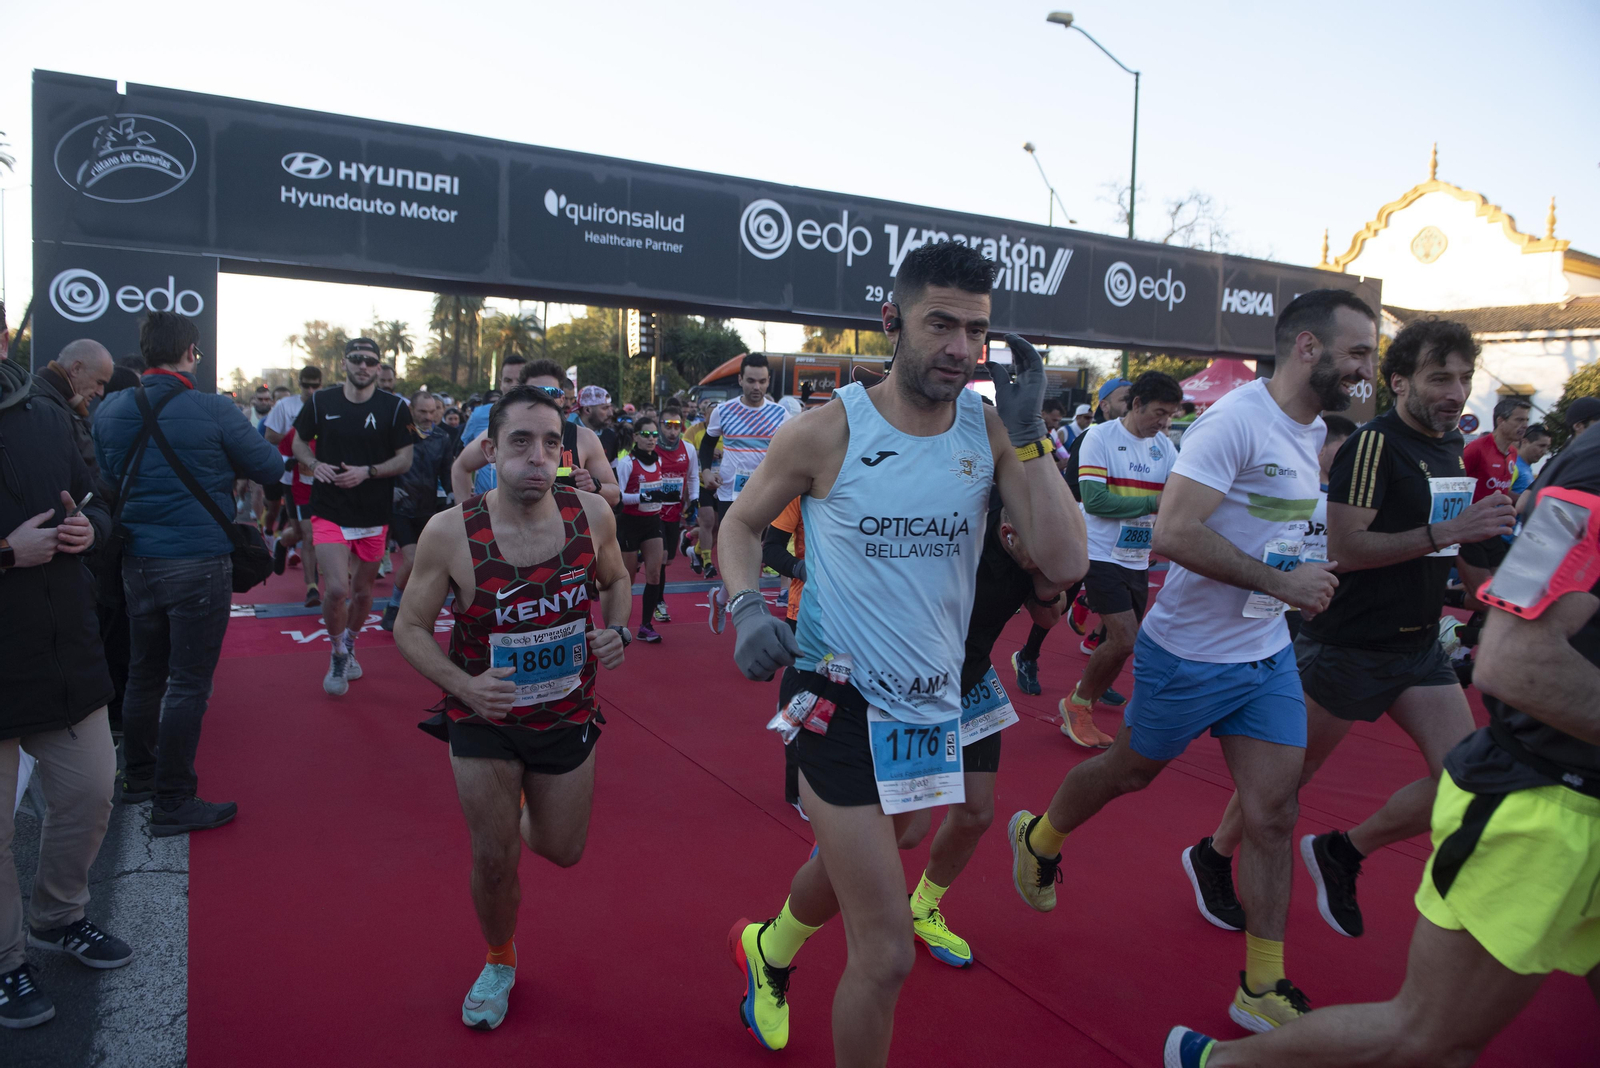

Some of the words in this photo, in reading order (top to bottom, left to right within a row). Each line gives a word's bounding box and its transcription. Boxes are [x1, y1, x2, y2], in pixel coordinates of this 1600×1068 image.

[120, 151, 131, 164] de
[132, 150, 172, 170] Canarias
[339, 160, 459, 195] HYUNDAI
[281, 186, 396, 217] Hyundauto
[400, 201, 458, 224] Motor
[585, 230, 643, 249] Healthcare
[645, 238, 684, 254] Partner
[797, 210, 873, 267] edp
[115, 275, 204, 318] edp
[865, 285, 884, 302] 29
[1139, 268, 1187, 312] edp
[1221, 287, 1275, 318] HOKA
[1129, 462, 1151, 474] Pablo
[663, 484, 678, 492] 662
[1443, 497, 1463, 521] 972
[1124, 530, 1150, 543] 2883
[865, 543, 961, 559] BELLAVISTA
[495, 584, 589, 626] KENYA
[508, 645, 566, 674] 1860
[887, 726, 941, 761] 1776
[1018, 822, 1027, 843] HOKA
